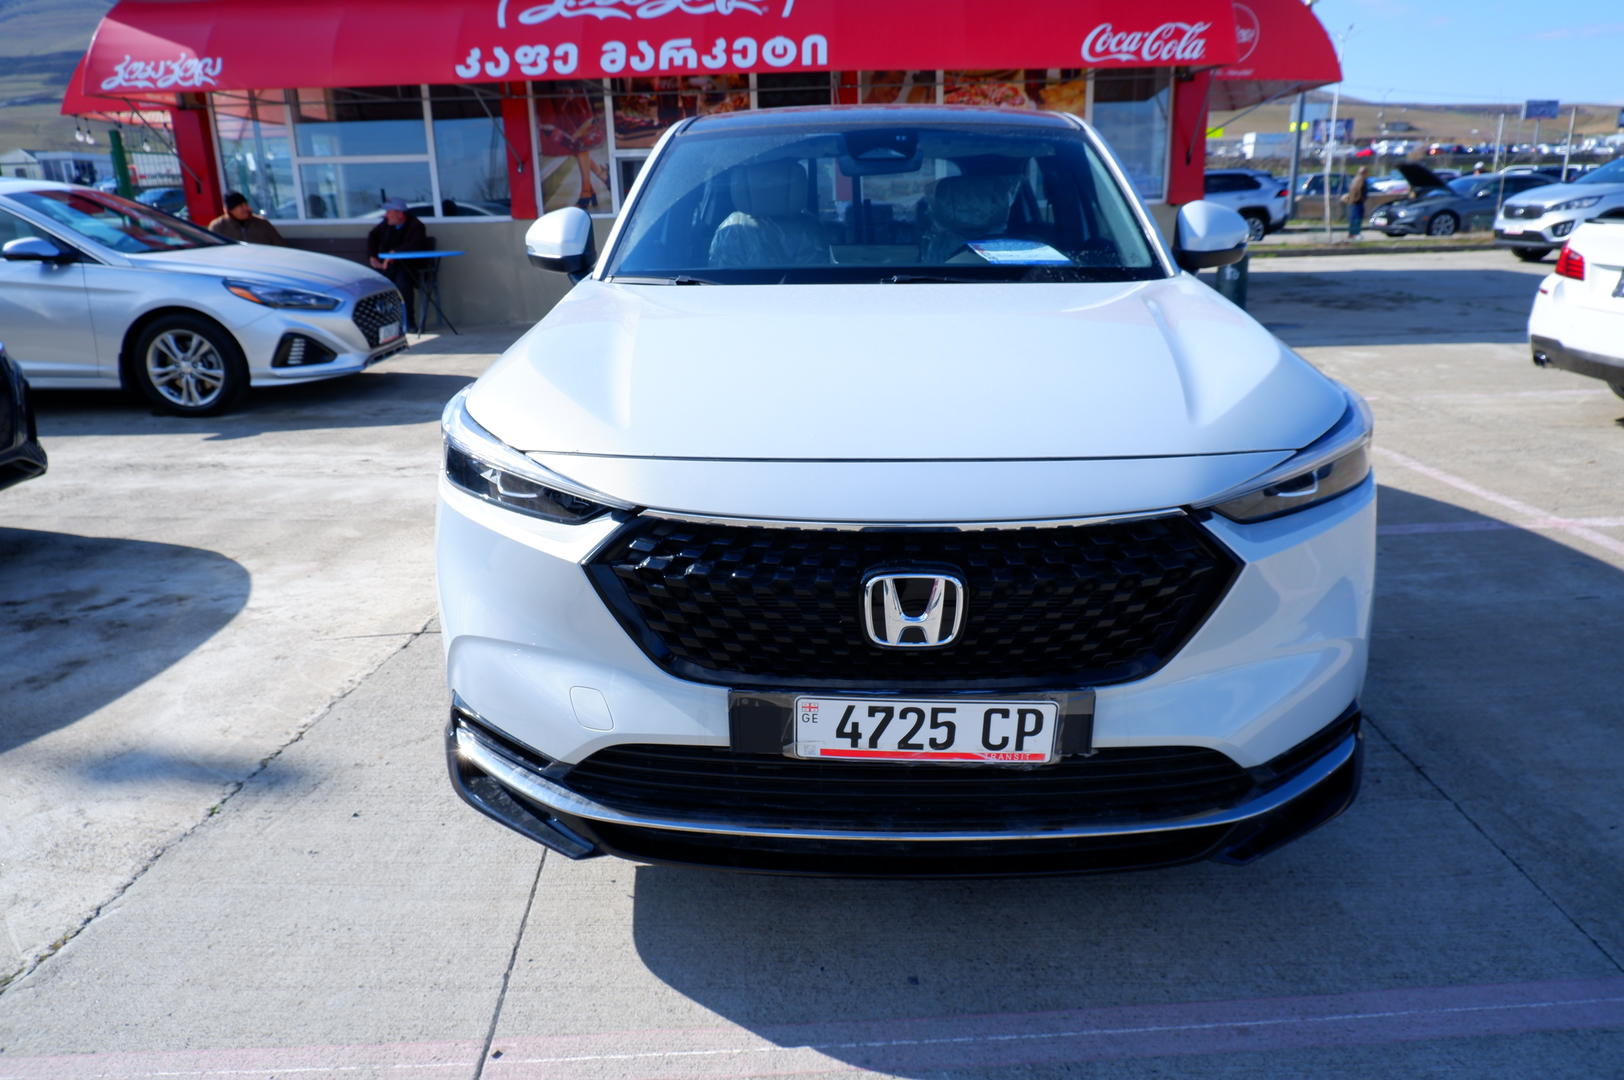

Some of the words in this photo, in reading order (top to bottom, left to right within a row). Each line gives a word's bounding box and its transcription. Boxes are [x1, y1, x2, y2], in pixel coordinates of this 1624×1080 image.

[455, 42, 579, 78] კაფე
[600, 34, 828, 73] მარკეტი
[1081, 21, 1212, 63] Coca-Cola
[801, 712, 819, 724] GE
[835, 704, 957, 751] 4725
[981, 707, 1044, 752] CP
